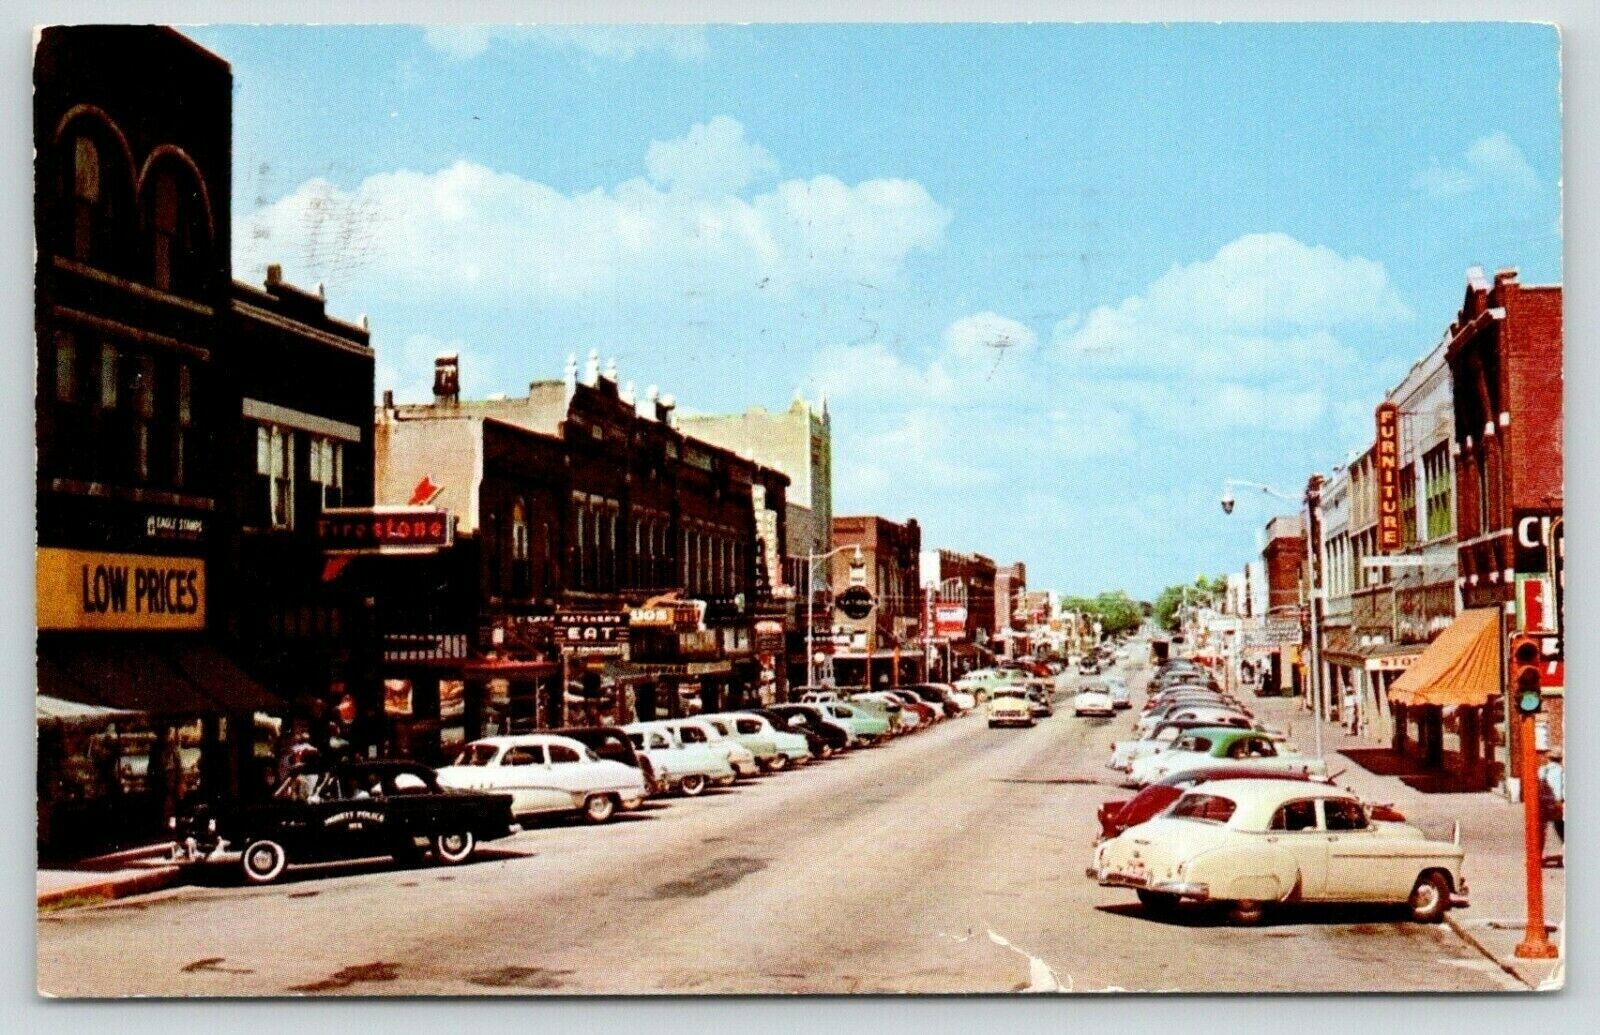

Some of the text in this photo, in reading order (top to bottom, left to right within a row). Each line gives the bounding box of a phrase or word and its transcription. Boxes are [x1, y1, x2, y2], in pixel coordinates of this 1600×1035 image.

[1380, 410, 1398, 543] FURNITURE
[83, 564, 199, 615] LOW PRICES
[568, 627, 615, 640] EAT
